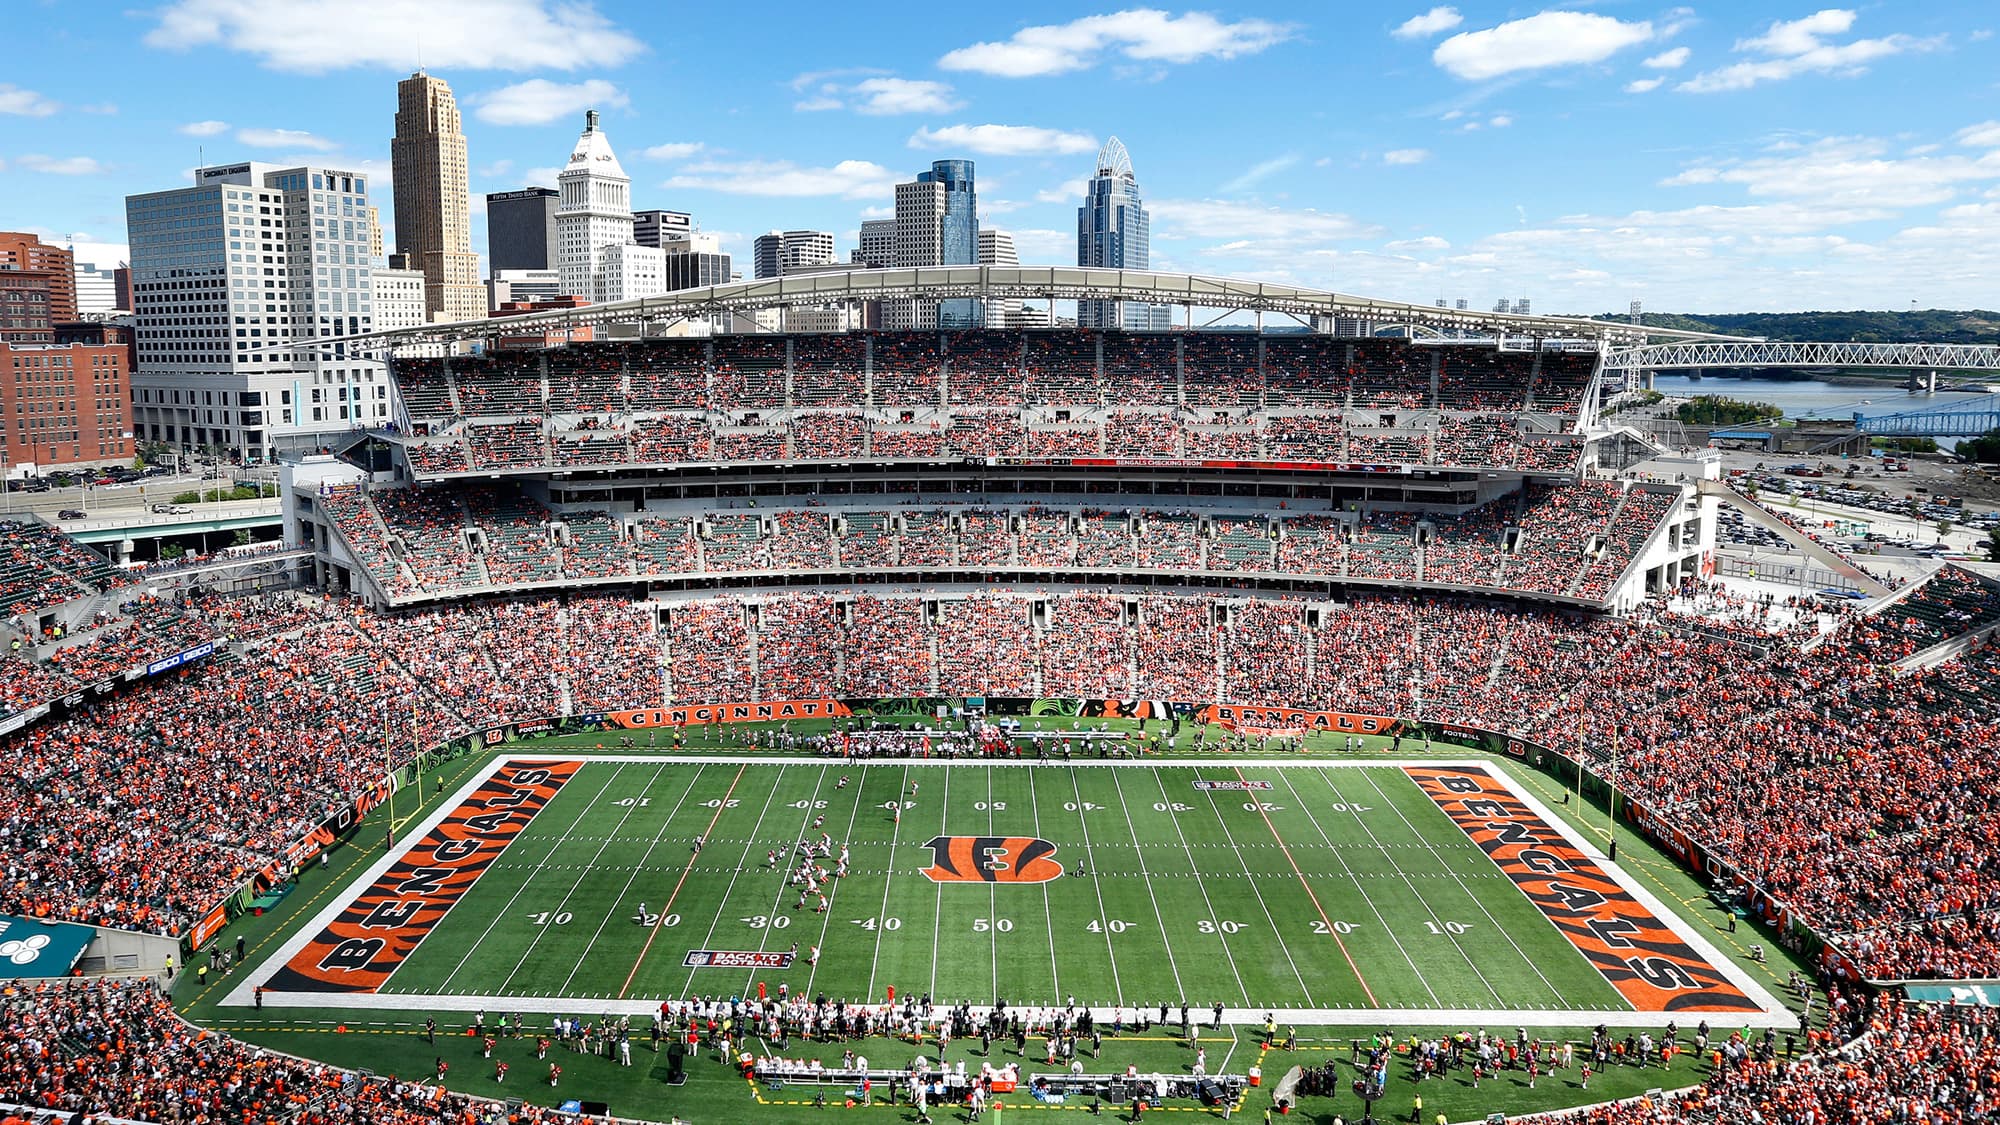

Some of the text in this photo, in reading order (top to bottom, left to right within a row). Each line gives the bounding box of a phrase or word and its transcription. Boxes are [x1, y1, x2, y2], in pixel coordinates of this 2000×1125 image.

[323, 169, 354, 178] ENQUIRER
[150, 644, 212, 673] GEICO GEICO
[631, 702, 835, 725] CINCINNATI
[1218, 707, 1378, 731] BENGALS
[518, 724, 554, 734] FOOTBALL
[315, 768, 552, 972] BENGALS
[1434, 774, 1704, 990] BENGALS
[534, 911, 574, 925] 10
[640, 913, 681, 927] 20
[750, 915, 791, 929] 30
[861, 917, 901, 931] 40
[973, 919, 1014, 932] 50
[1086, 919, 1126, 933] 40
[1197, 920, 1239, 934] 30
[1309, 920, 1352, 934] 20
[1424, 920, 1467, 935] 10
[712, 959, 779, 967] FOOTBALL
[715, 953, 757, 961] BACK
